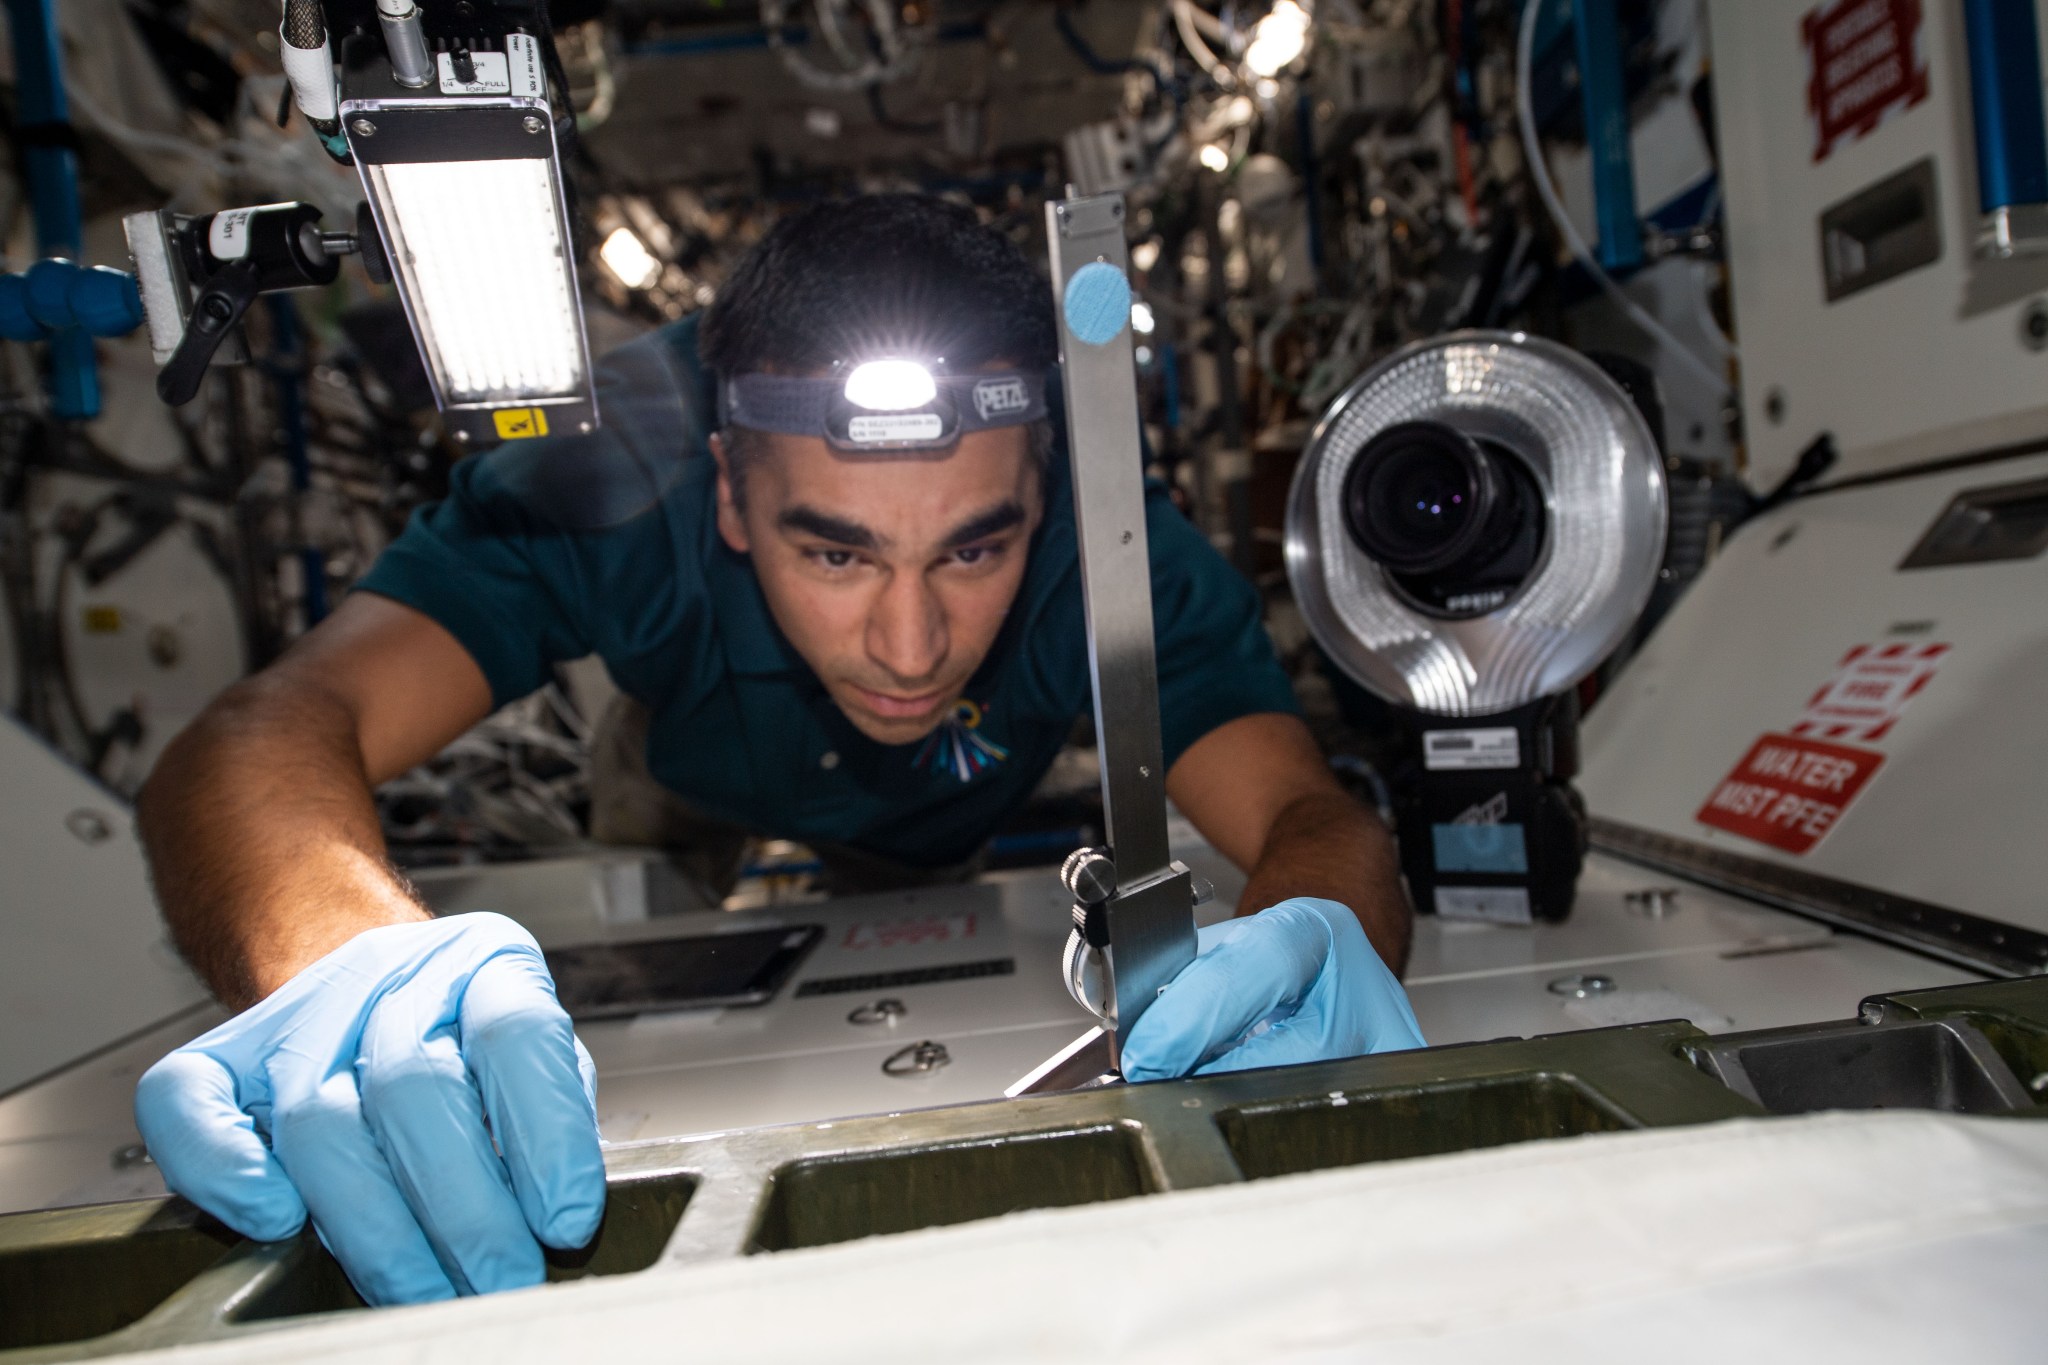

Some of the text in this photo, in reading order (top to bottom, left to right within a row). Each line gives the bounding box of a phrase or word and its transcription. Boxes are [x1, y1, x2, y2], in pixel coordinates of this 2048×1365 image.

[1751, 746, 1857, 793] WATER
[1711, 781, 1840, 837] MIST PFE
